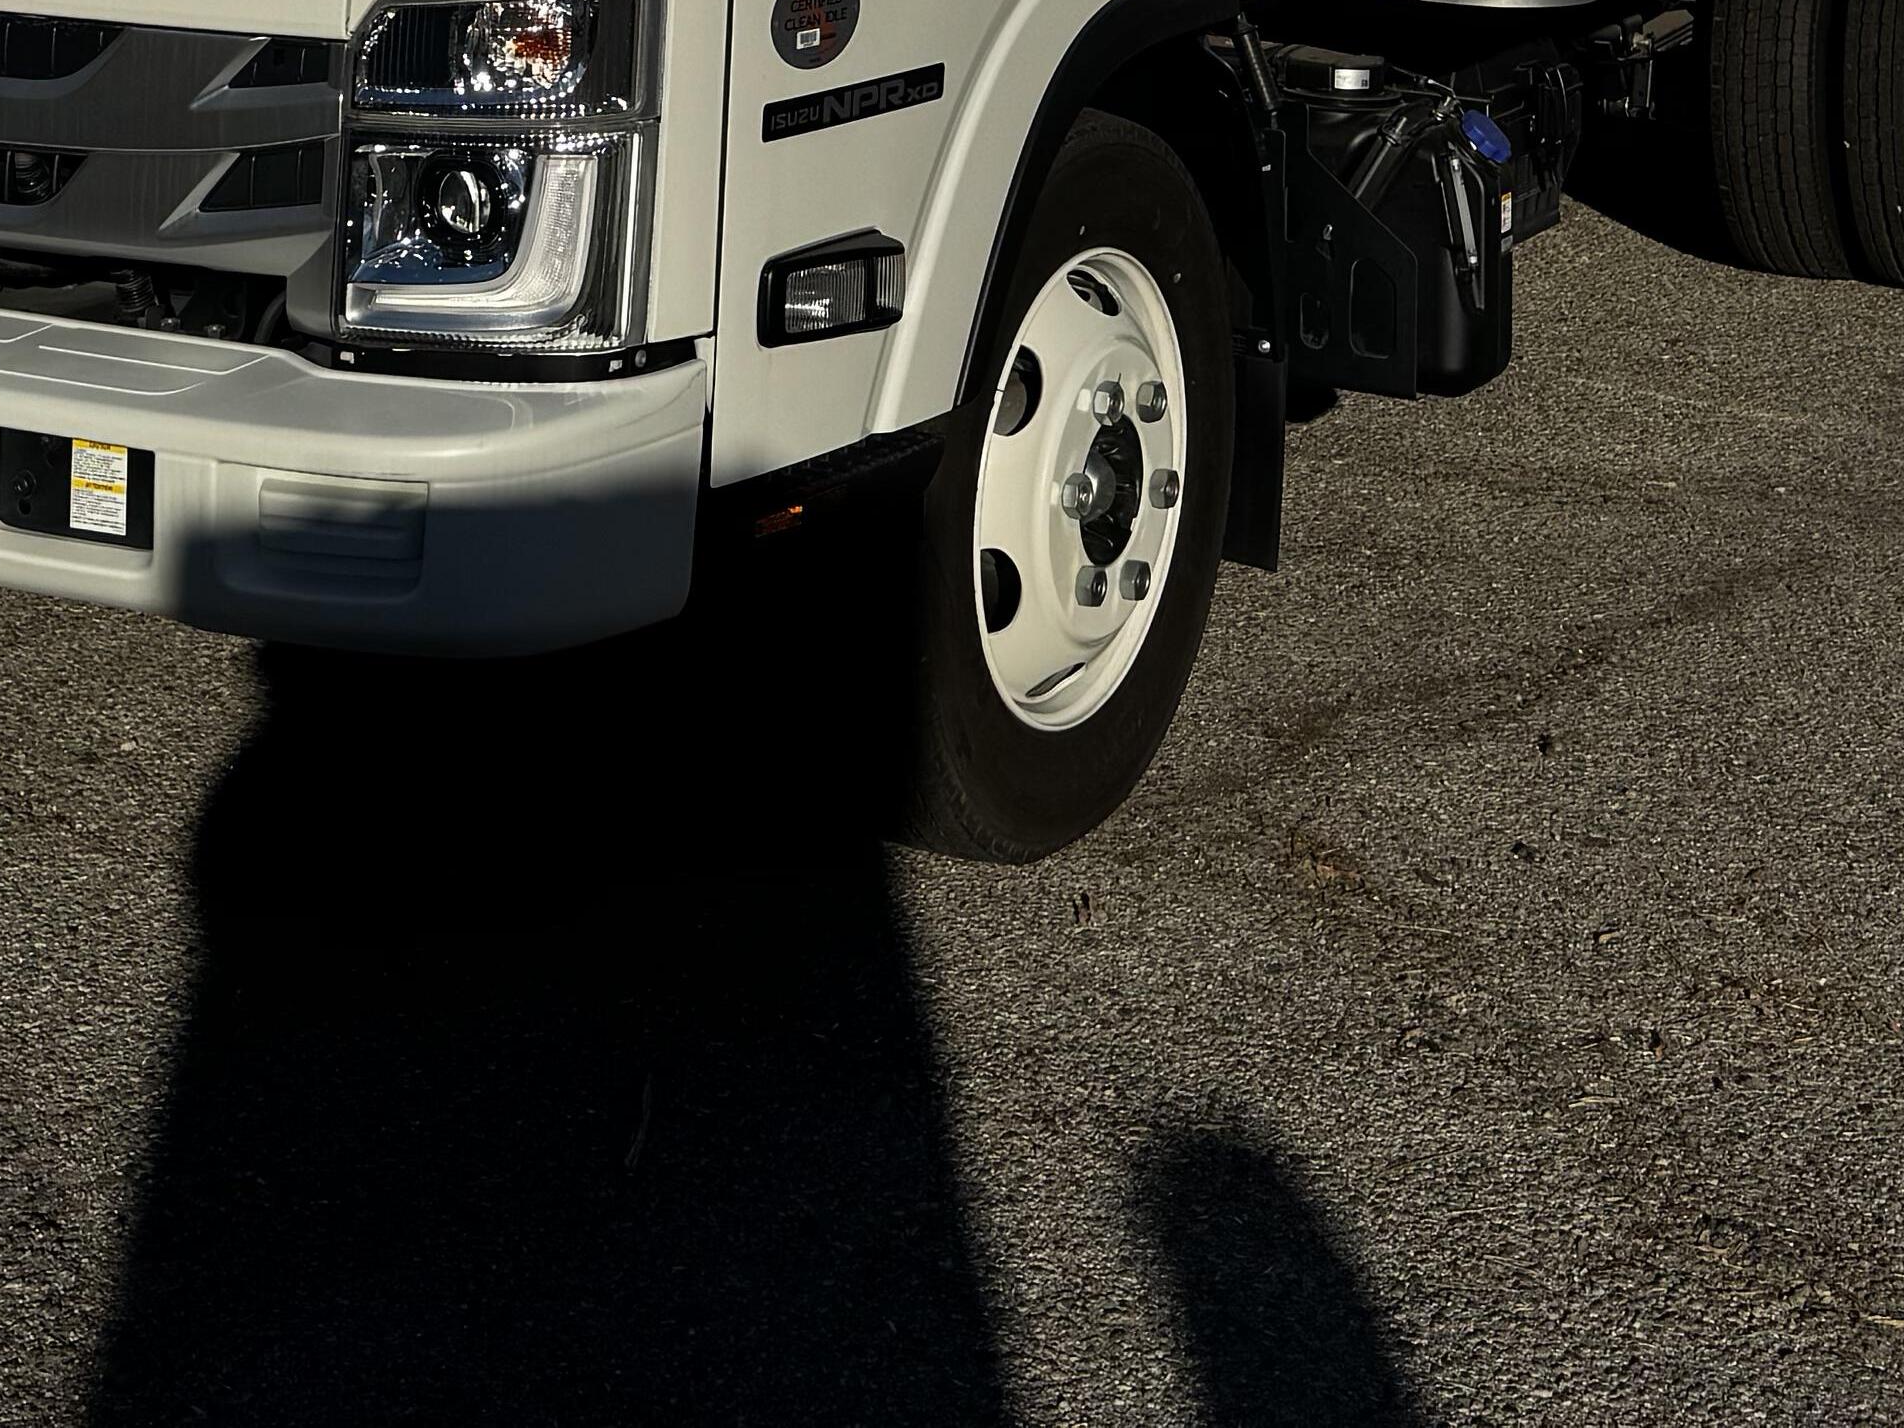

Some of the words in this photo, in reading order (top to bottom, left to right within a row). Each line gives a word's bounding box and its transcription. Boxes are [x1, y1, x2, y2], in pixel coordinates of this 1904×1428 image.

[784, 12, 821, 32] CLEAN
[770, 104, 820, 131] ISUZU
[822, 78, 906, 123] NPR
